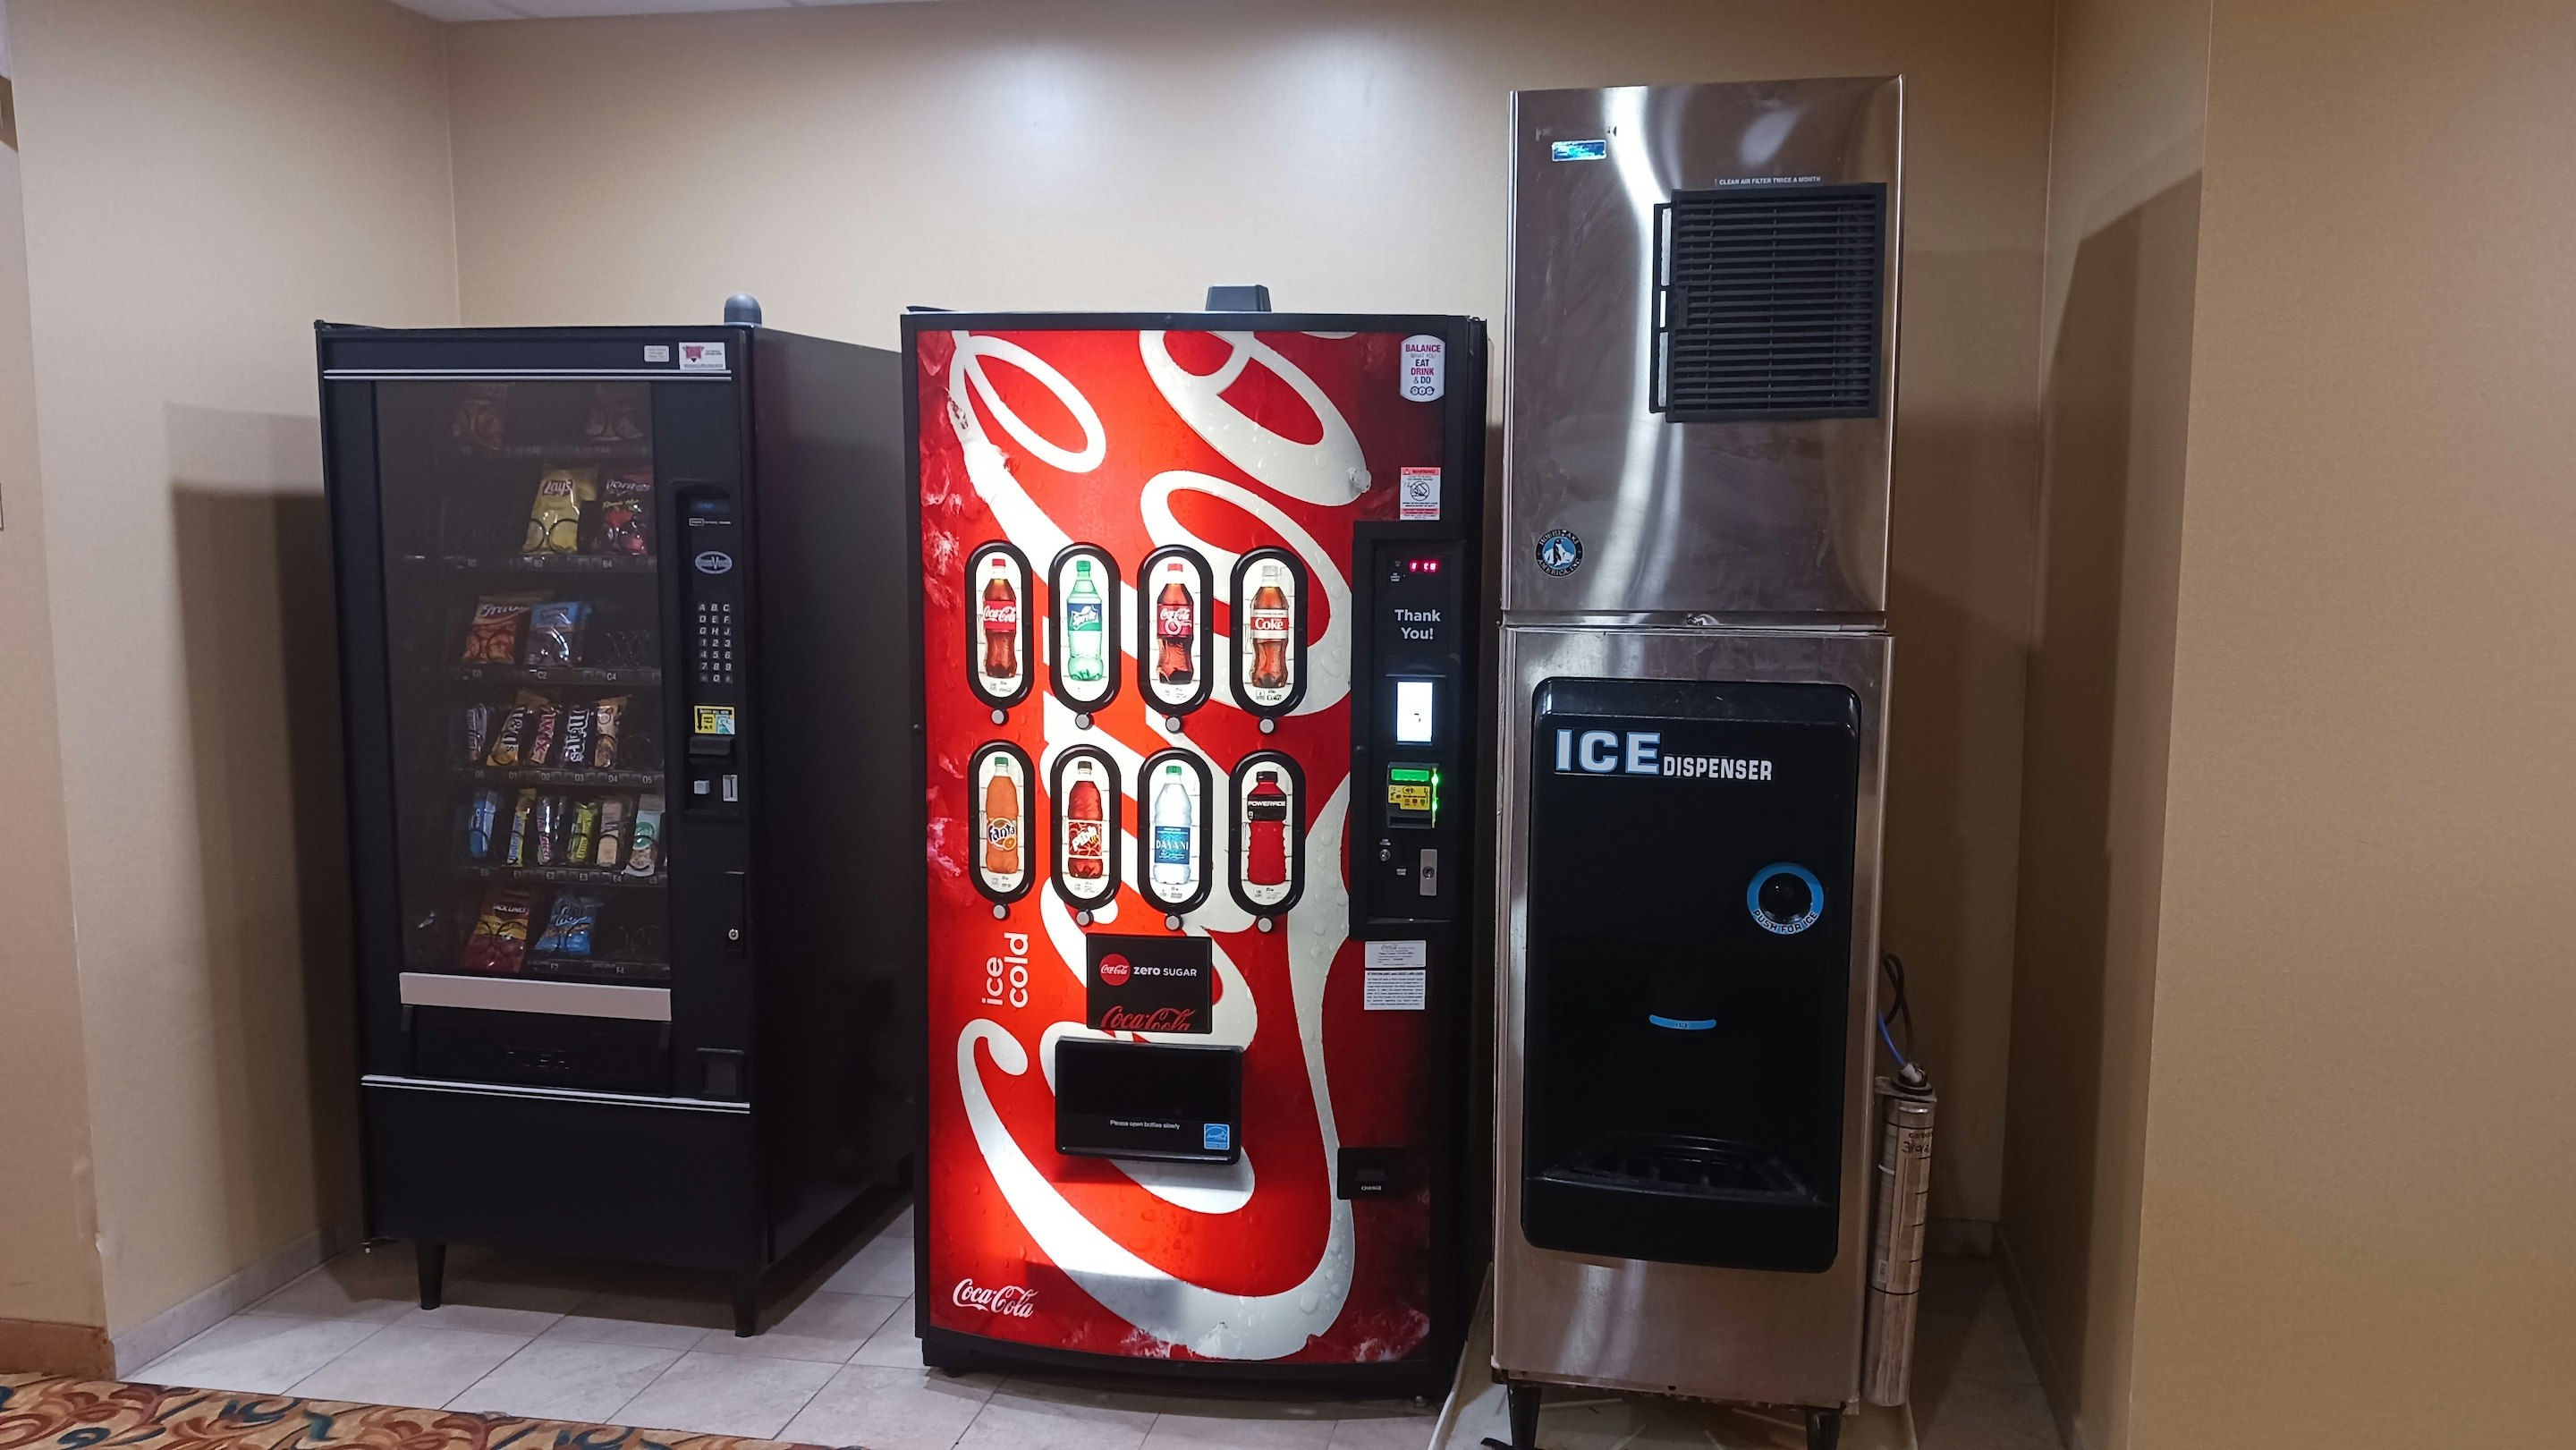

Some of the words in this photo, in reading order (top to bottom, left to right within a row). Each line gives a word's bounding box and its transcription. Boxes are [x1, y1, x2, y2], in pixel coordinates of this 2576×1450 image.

[1405, 344, 1441, 352] BALANCE
[1415, 359, 1430, 367] EAT
[1411, 368, 1434, 376] DRINK
[1413, 376, 1419, 384] &
[1420, 376, 1431, 384] DO
[603, 560, 612, 568] B4
[723, 604, 729, 612] C
[712, 615, 717, 623] E
[724, 615, 730, 623] F
[1394, 609, 1441, 622] Thank
[1254, 617, 1284, 630] Coke
[1401, 627, 1434, 640] You!
[724, 651, 731, 659] 6
[713, 663, 719, 671] 8
[606, 673, 616, 681] C4
[713, 674, 719, 683] 0
[1556, 729, 1661, 775] ICE
[1663, 756, 1772, 781] DISPENSER
[1156, 839, 1189, 851] DASANI
[1753, 910, 1777, 931] PUSH
[1781, 924, 1801, 932] FOR
[1803, 912, 1817, 927] ICE
[1004, 932, 1029, 1008] cold
[1100, 964, 1130, 975] Coca-Cola
[1133, 966, 1160, 976] zero
[1163, 967, 1197, 977] SUGAR
[981, 956, 1004, 1006] ice
[1100, 1005, 1196, 1031] Coca-Cola
[953, 1278, 1038, 1318] Coca-Cola
